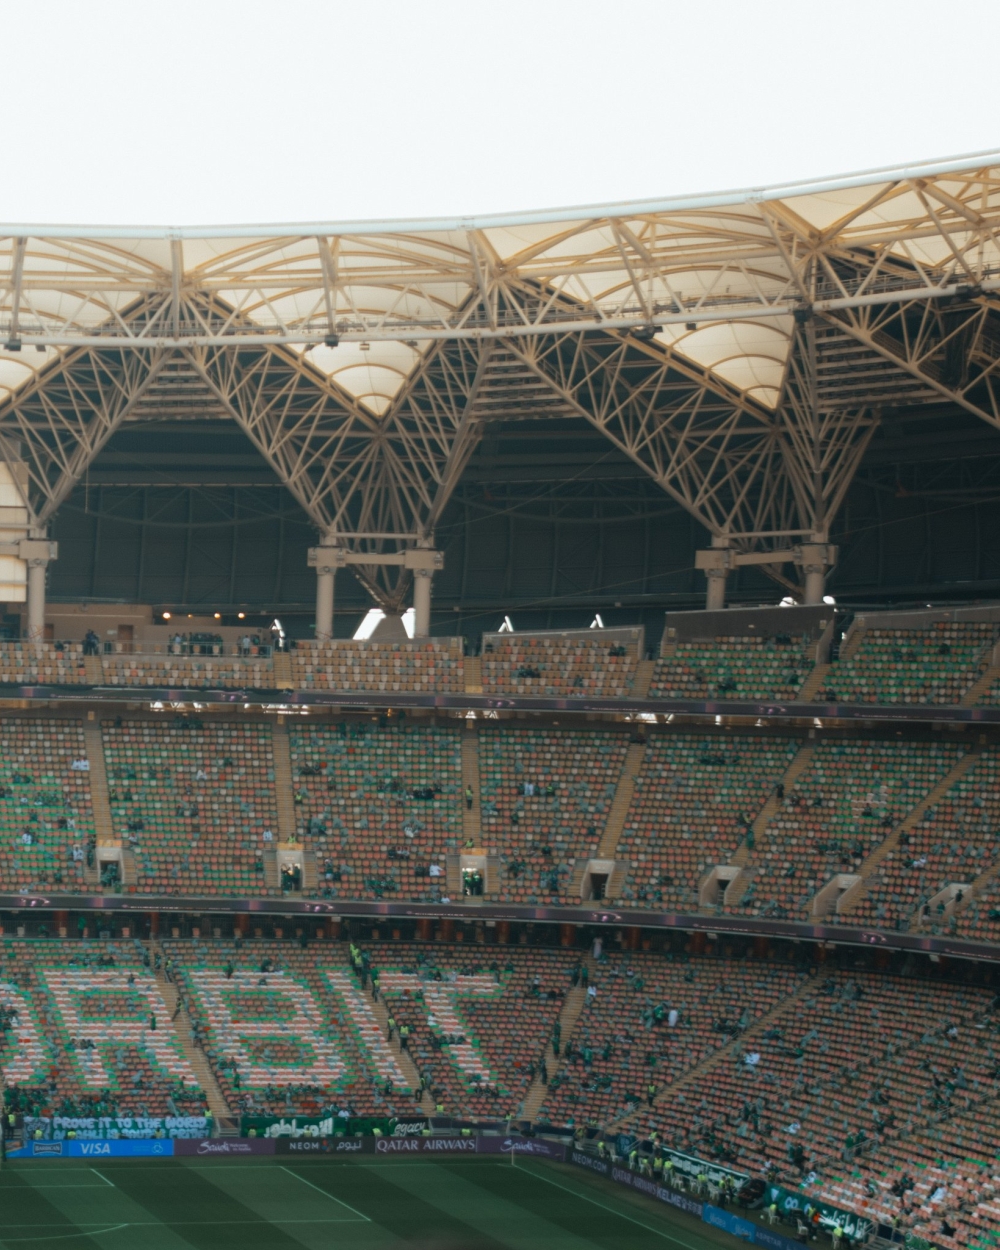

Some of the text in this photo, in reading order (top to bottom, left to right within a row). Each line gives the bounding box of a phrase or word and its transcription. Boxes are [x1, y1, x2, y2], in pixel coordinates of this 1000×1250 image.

[53, 1117, 94, 1129] PROVE
[98, 1117, 111, 1128] IT
[115, 1117, 132, 1128] TO
[135, 1118, 162, 1129] THE
[165, 1117, 207, 1129] WORLD
[80, 1143, 111, 1154] VISA
[289, 1142, 319, 1150] NEOM
[336, 1140, 362, 1151] نيوم
[377, 1139, 475, 1152] QATAR AIRWAYS
[572, 1151, 607, 1174] NEOM.COM
[656, 1186, 682, 1208] KELME
